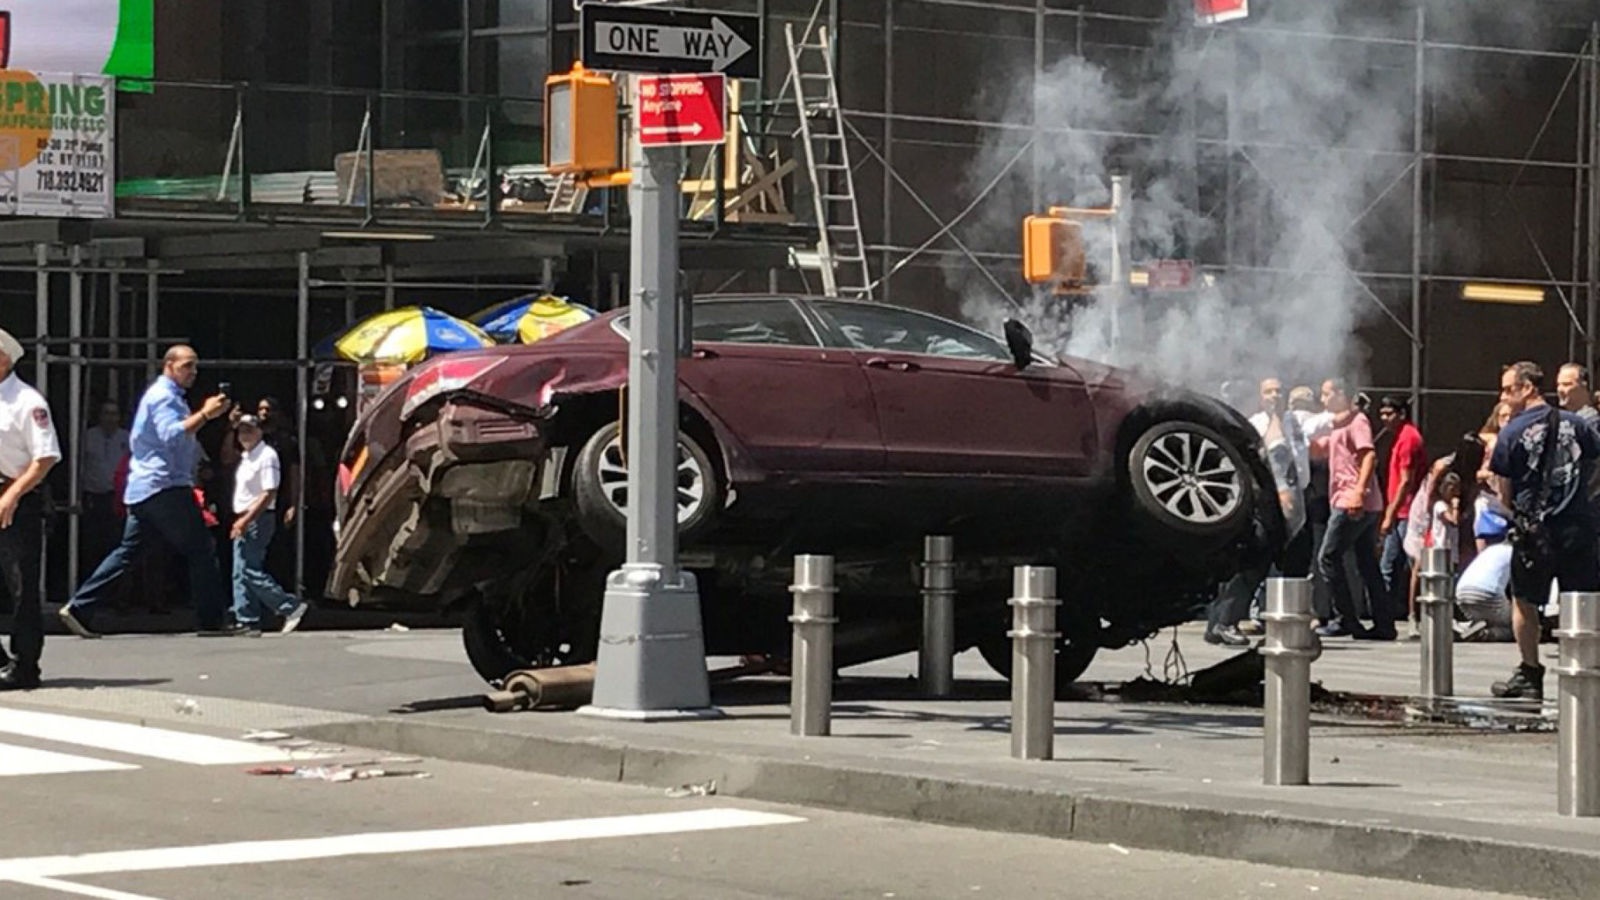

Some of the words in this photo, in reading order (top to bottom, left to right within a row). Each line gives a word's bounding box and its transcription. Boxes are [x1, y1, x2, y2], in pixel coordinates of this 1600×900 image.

[609, 26, 660, 53] ONE
[683, 31, 734, 58] WAY
[0, 82, 106, 116] PRING
[642, 83, 657, 97] NO
[659, 81, 705, 97] STOPPING
[82, 118, 105, 133] LLC
